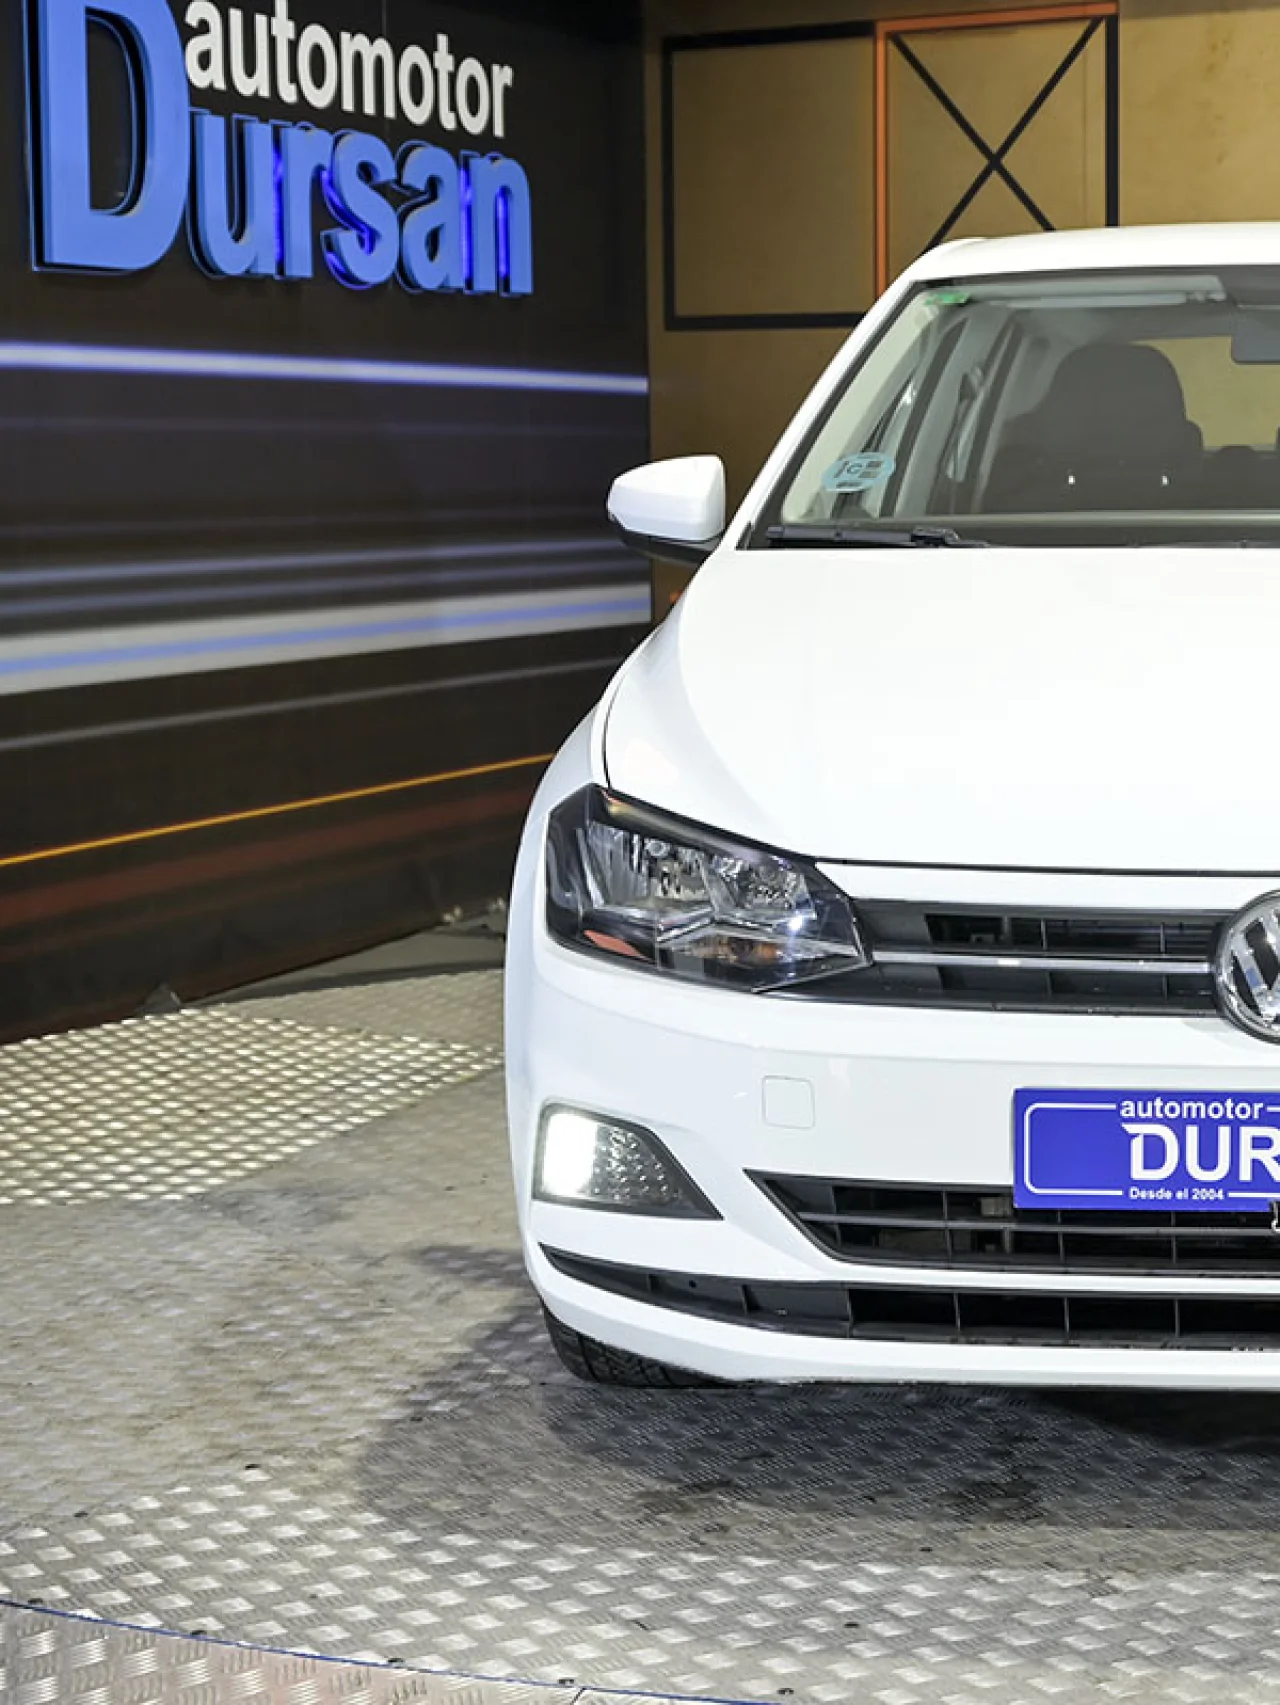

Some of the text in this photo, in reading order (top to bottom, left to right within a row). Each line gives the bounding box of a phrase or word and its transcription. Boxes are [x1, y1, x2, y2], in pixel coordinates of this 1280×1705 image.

[184, 0, 514, 138] automotor
[25, 0, 534, 296] Dursan
[1119, 1097, 1264, 1120] automotor
[1129, 1186, 1225, 1201] Desde el 2004
